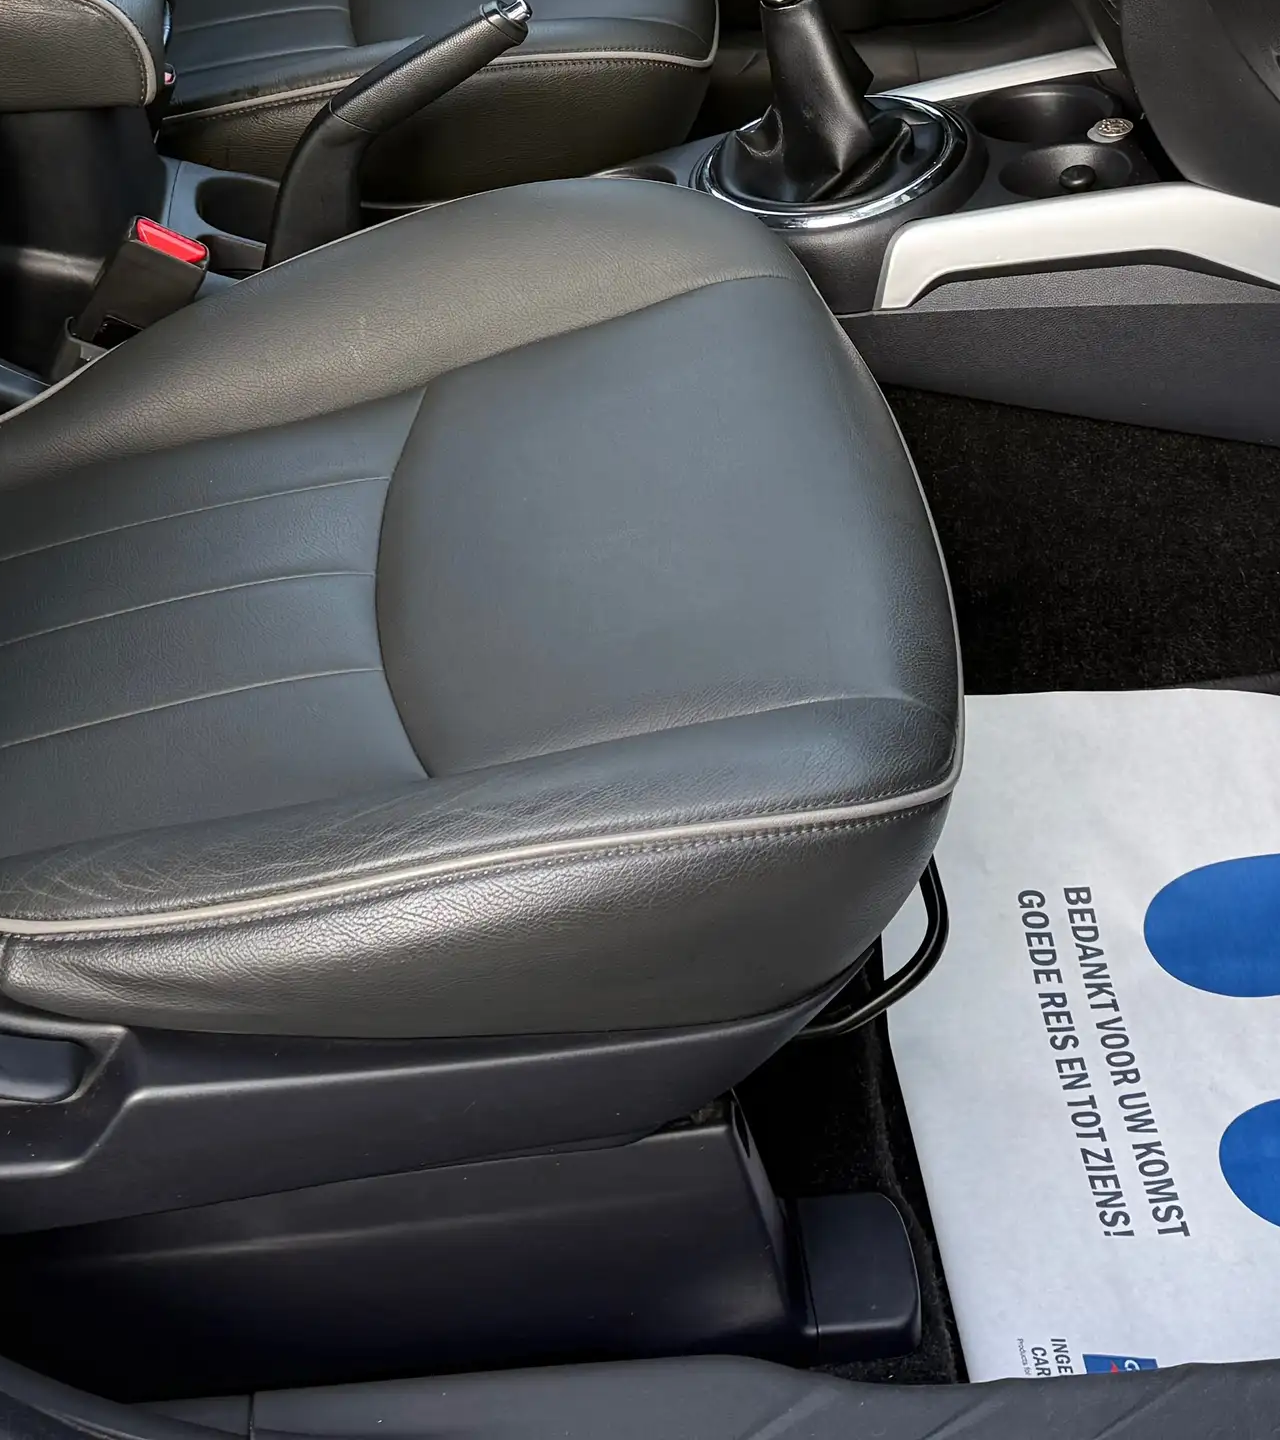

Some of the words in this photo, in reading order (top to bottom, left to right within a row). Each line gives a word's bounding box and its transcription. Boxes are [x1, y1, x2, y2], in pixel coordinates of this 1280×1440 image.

[1017, 889, 1064, 985] GOEDE
[1063, 886, 1120, 1013] BEDANKT
[1037, 991, 1080, 1051] REIS
[1095, 1015, 1141, 1087] VOOR
[1055, 1056, 1092, 1091] EN
[1066, 1094, 1108, 1143] TOT
[1117, 1091, 1159, 1133] UW
[1079, 1147, 1135, 1237] ZIENS!
[1131, 1140, 1191, 1237] KOMST
[1030, 1346, 1052, 1377] CAR
[1050, 1338, 1074, 1374] INGE
